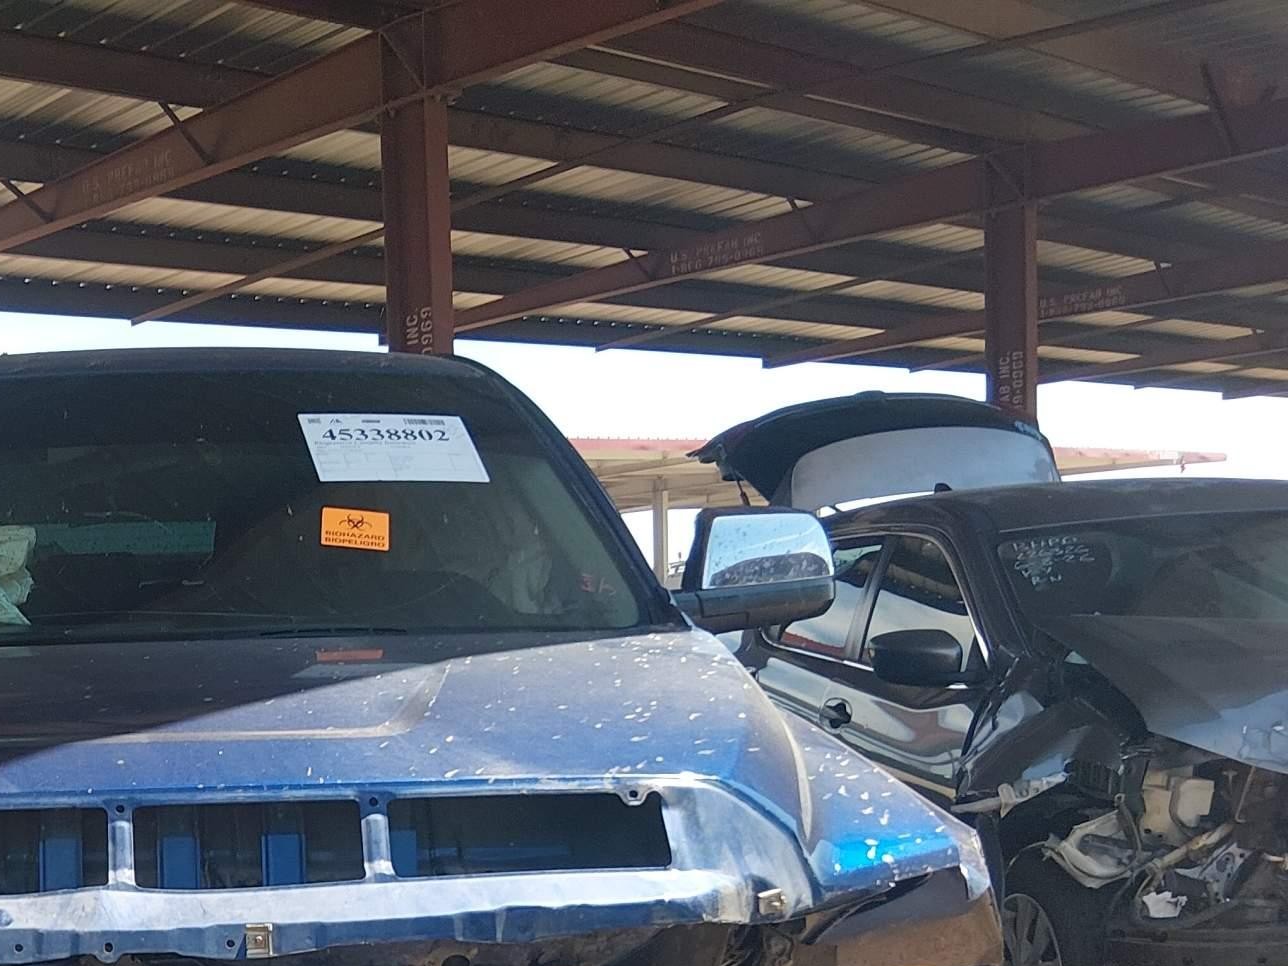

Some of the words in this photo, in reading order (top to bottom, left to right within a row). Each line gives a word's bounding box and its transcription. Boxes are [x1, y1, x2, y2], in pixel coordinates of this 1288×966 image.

[322, 428, 450, 442] 45338802
[325, 530, 385, 541] BIOHAZARD
[324, 537, 385, 548] BIOPELIGRO
